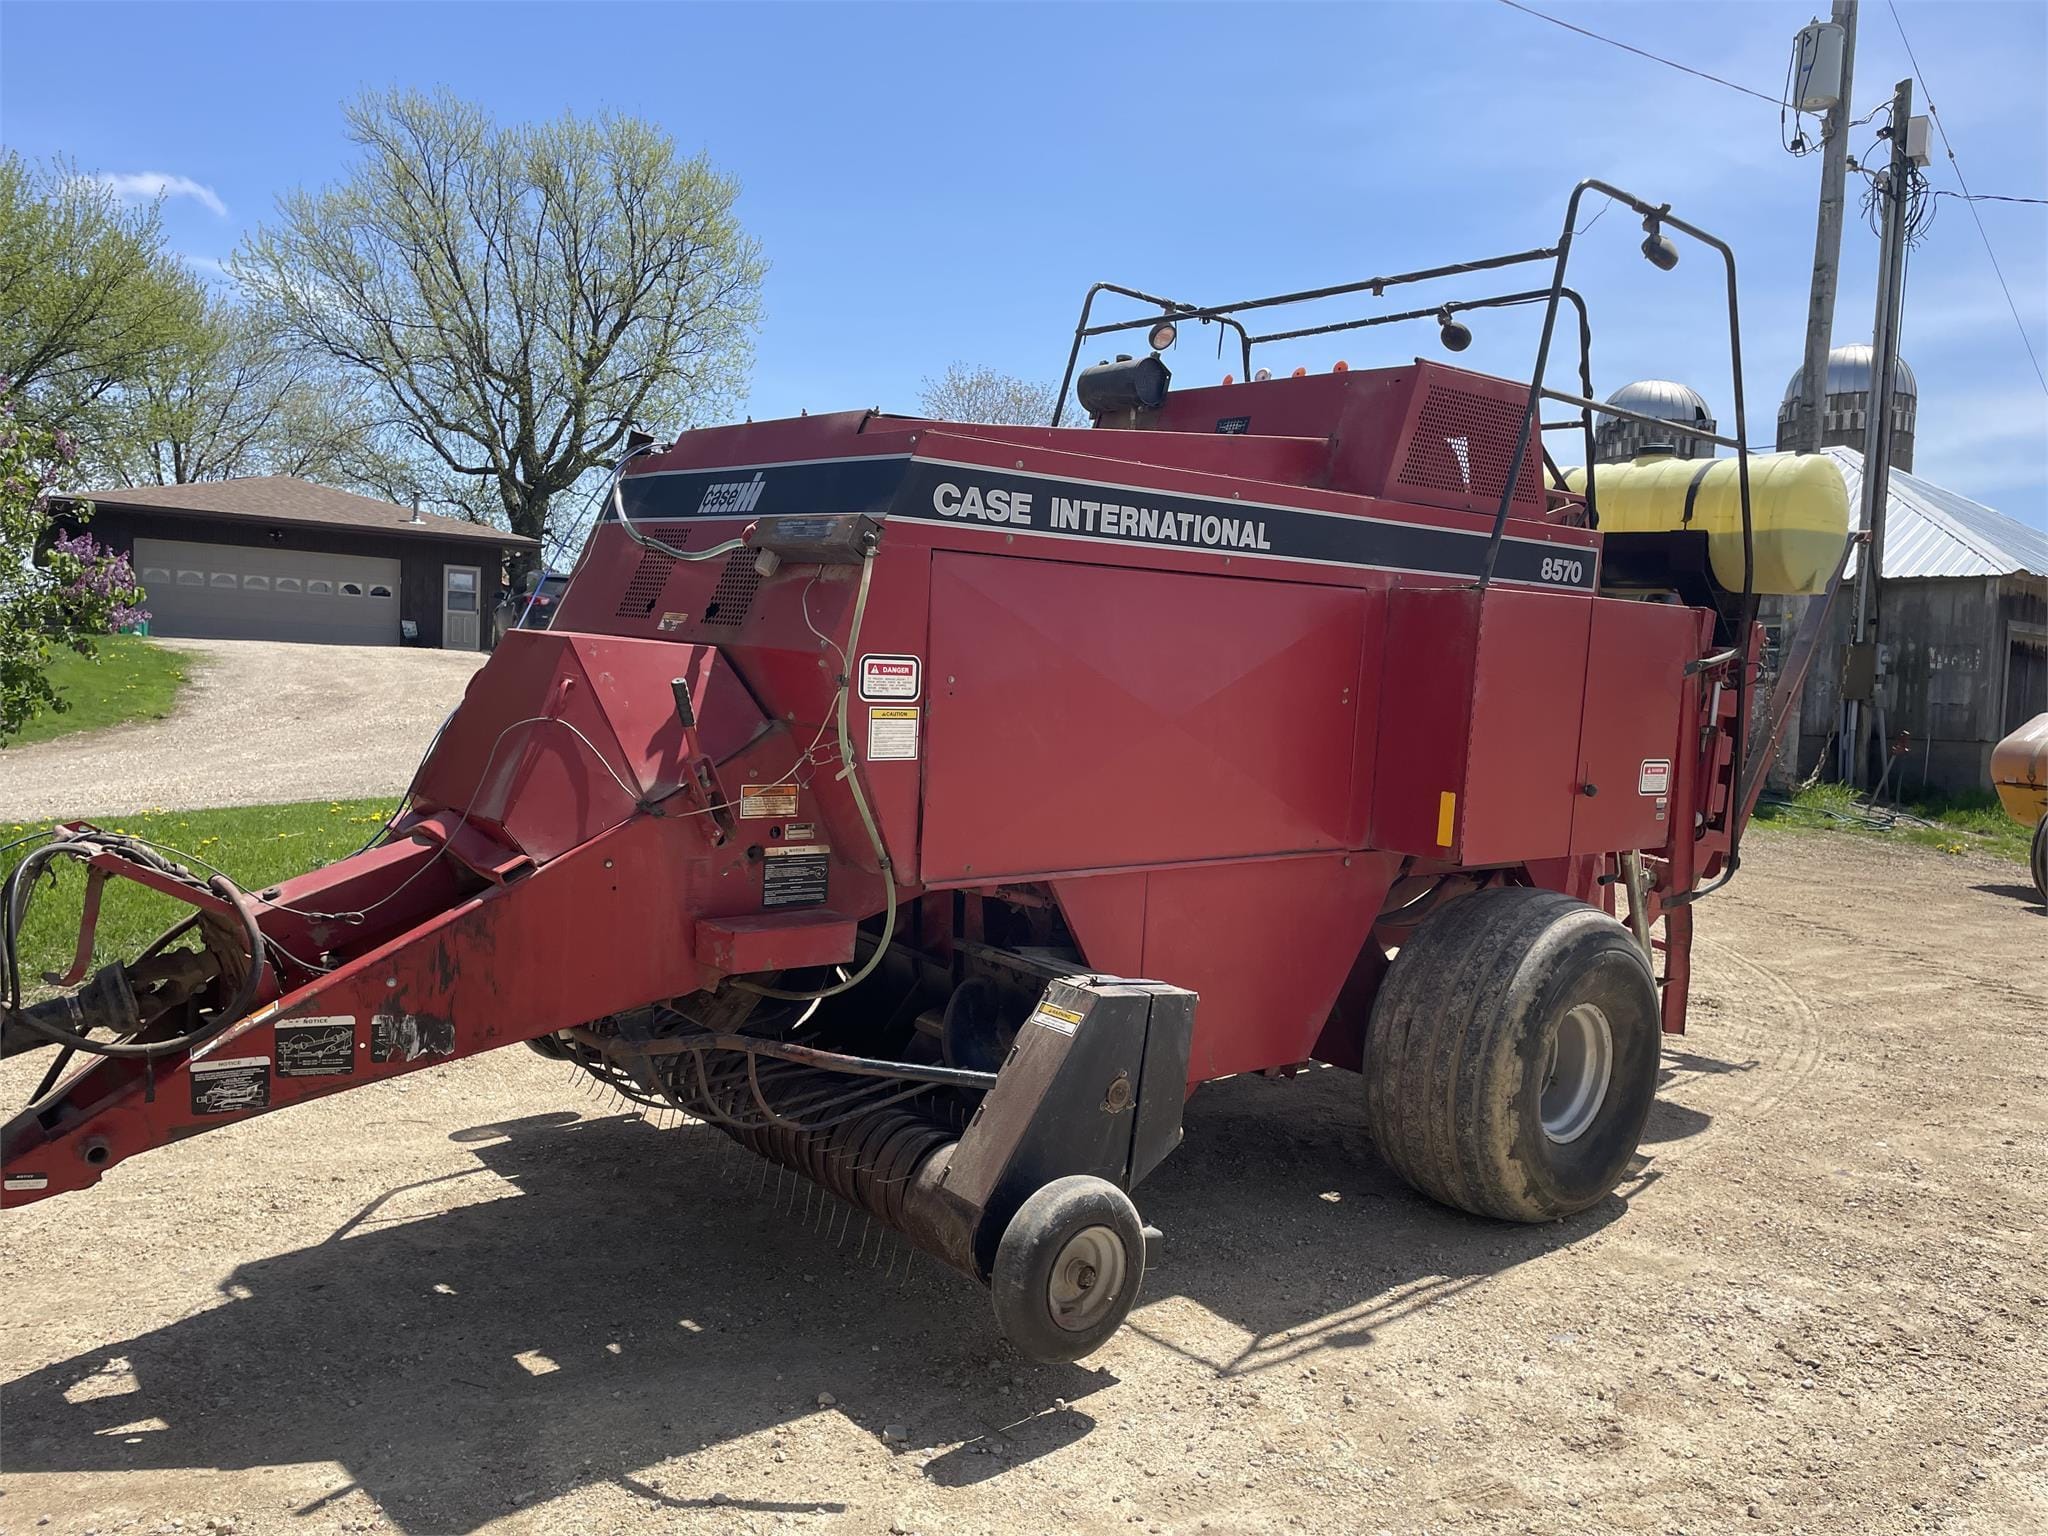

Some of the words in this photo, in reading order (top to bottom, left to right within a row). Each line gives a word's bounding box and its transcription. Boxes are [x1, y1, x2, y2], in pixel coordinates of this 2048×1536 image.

[933, 482, 1032, 524] CASE
[1050, 497, 1271, 549] INTERNATIONAL
[1541, 558, 1583, 583] 8570
[882, 666, 910, 674] DANGER
